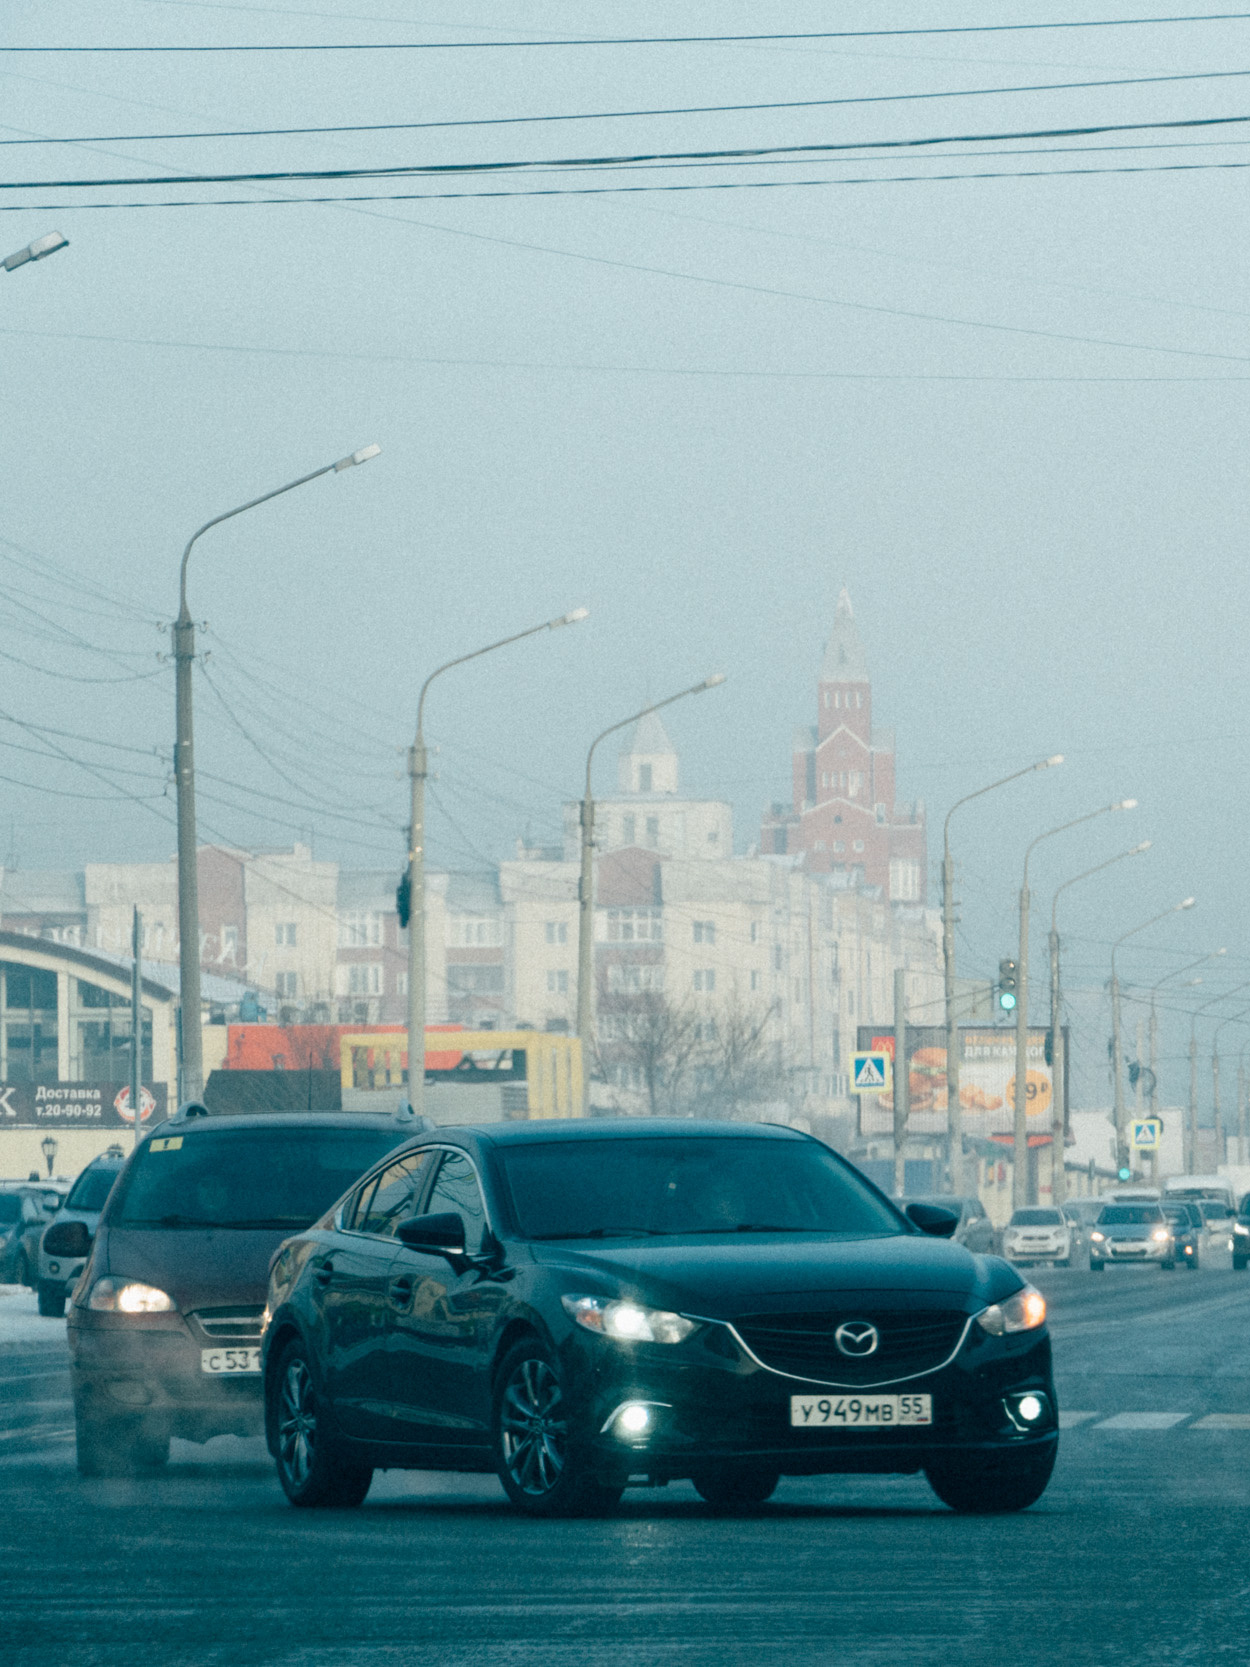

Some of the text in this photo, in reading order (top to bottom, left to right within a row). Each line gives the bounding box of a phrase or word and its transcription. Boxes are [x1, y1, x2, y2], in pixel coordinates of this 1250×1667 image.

[35, 1085, 101, 1101] Доставка
[35, 1104, 102, 1117] т.20-90-92
[801, 1397, 923, 1423] У949МВ 55
